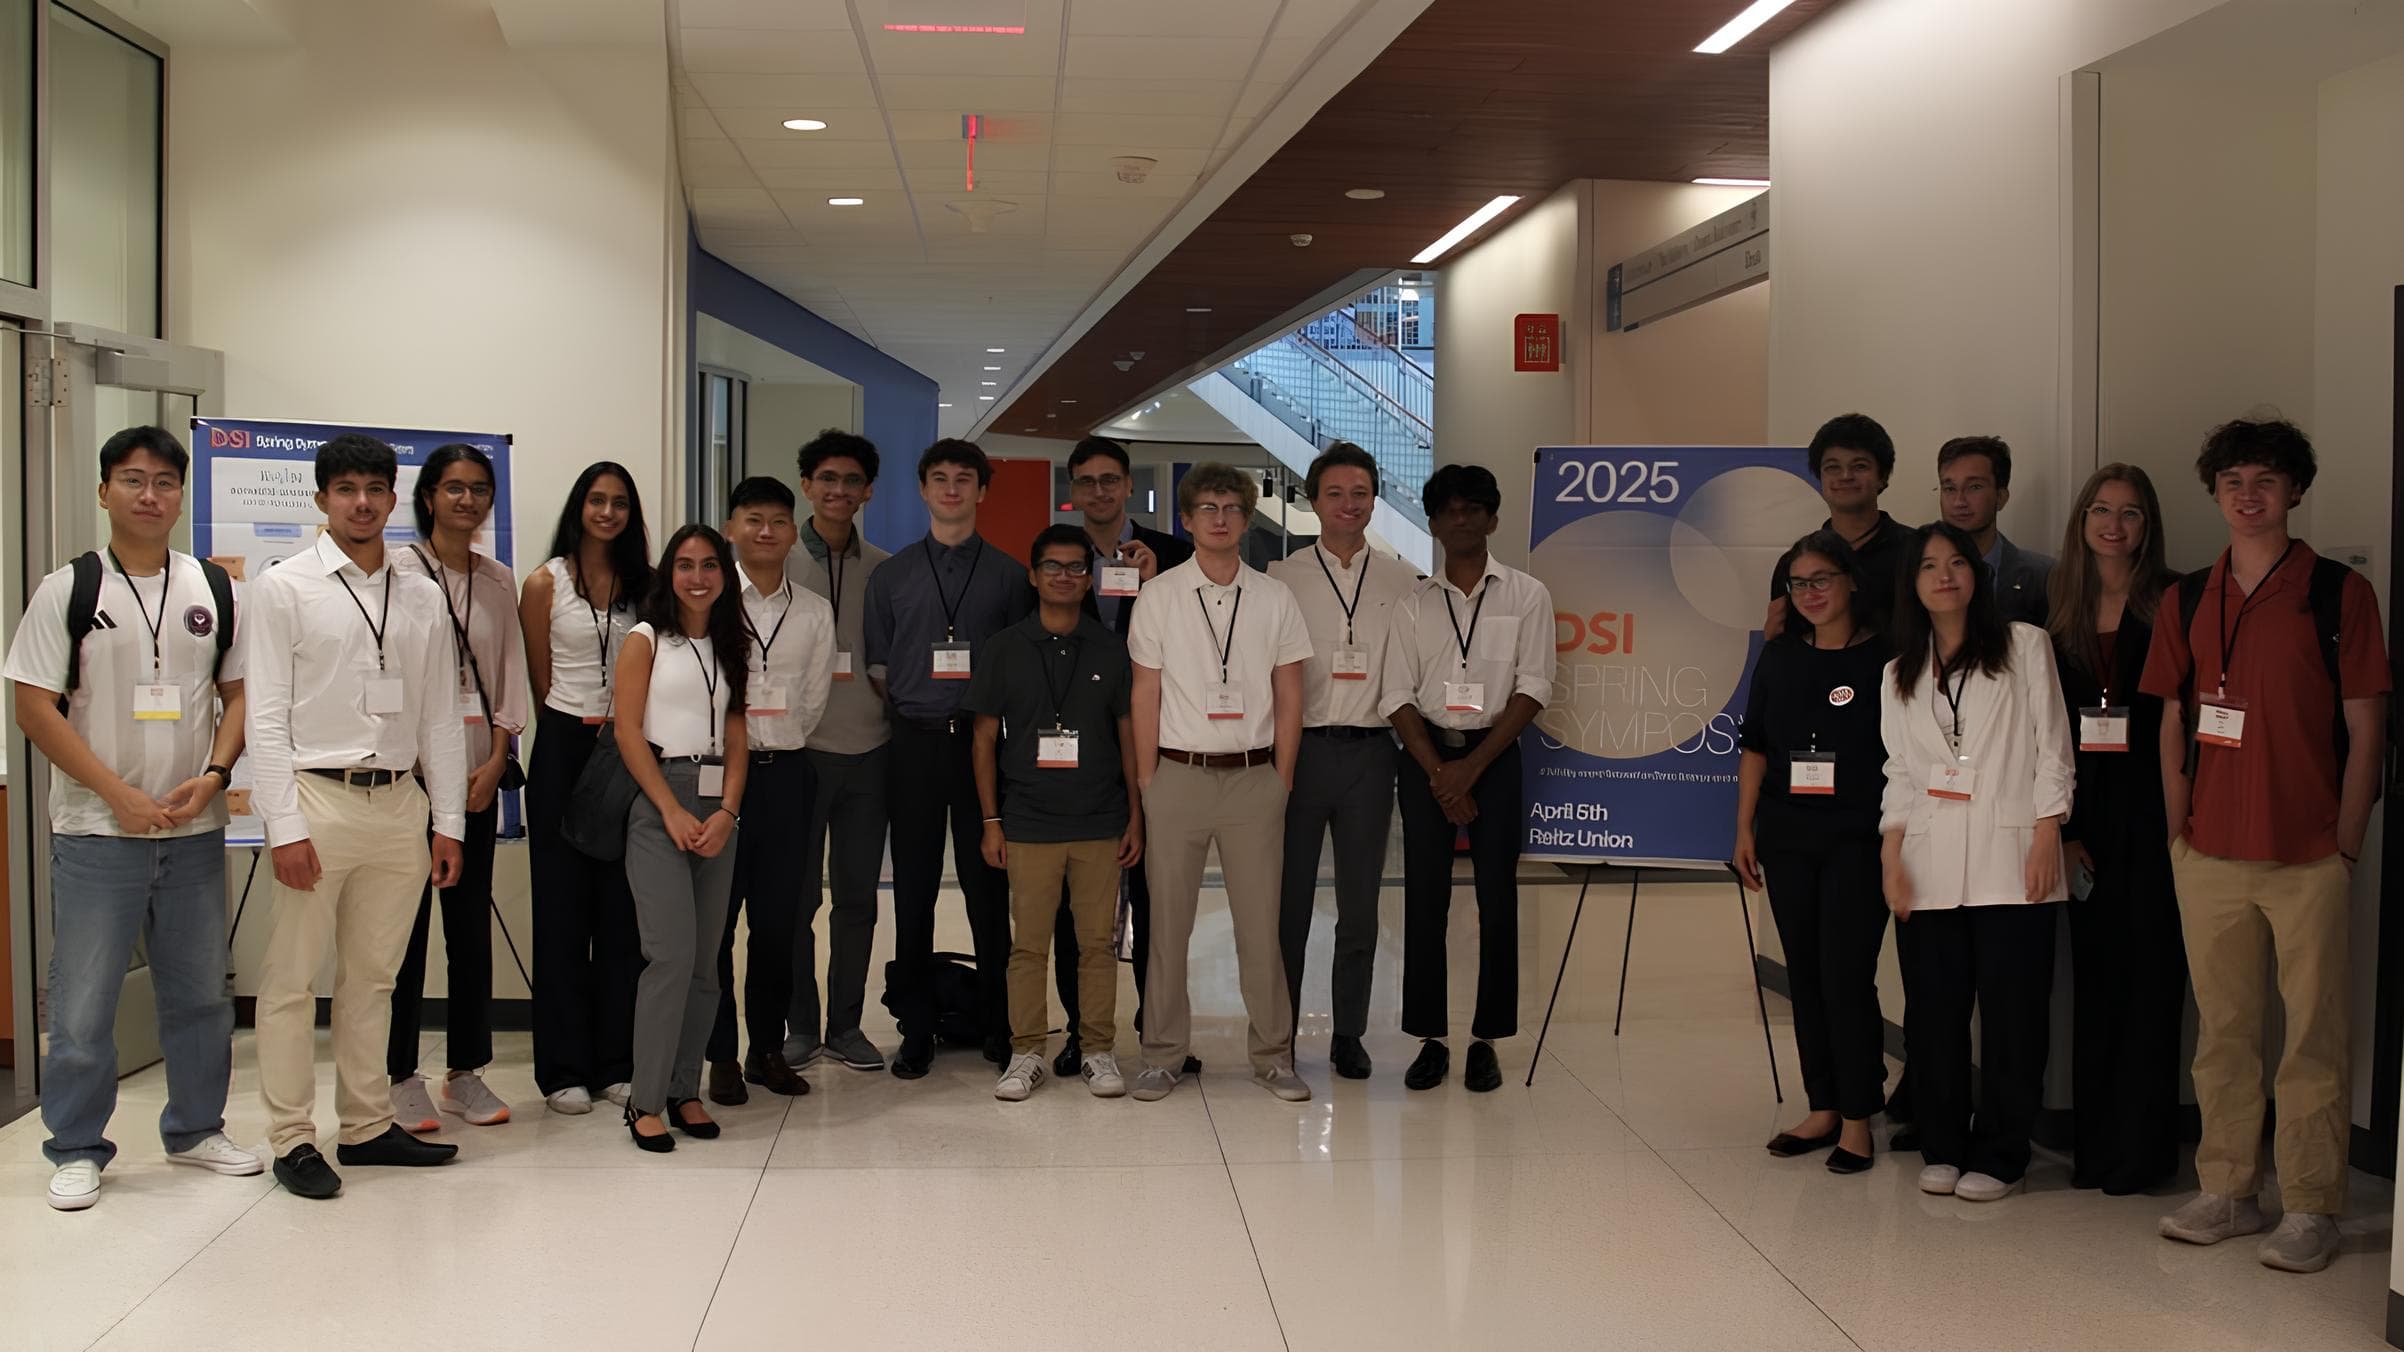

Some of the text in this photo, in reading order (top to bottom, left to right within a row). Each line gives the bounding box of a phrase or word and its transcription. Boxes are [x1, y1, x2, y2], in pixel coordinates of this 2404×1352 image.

[210, 427, 251, 448] DSI
[1555, 461, 1680, 503] 2025
[1555, 612, 1634, 654] DSI
[1551, 663, 1708, 707] SPRING
[1530, 802, 1573, 822] April
[1577, 829, 1634, 848] Union
